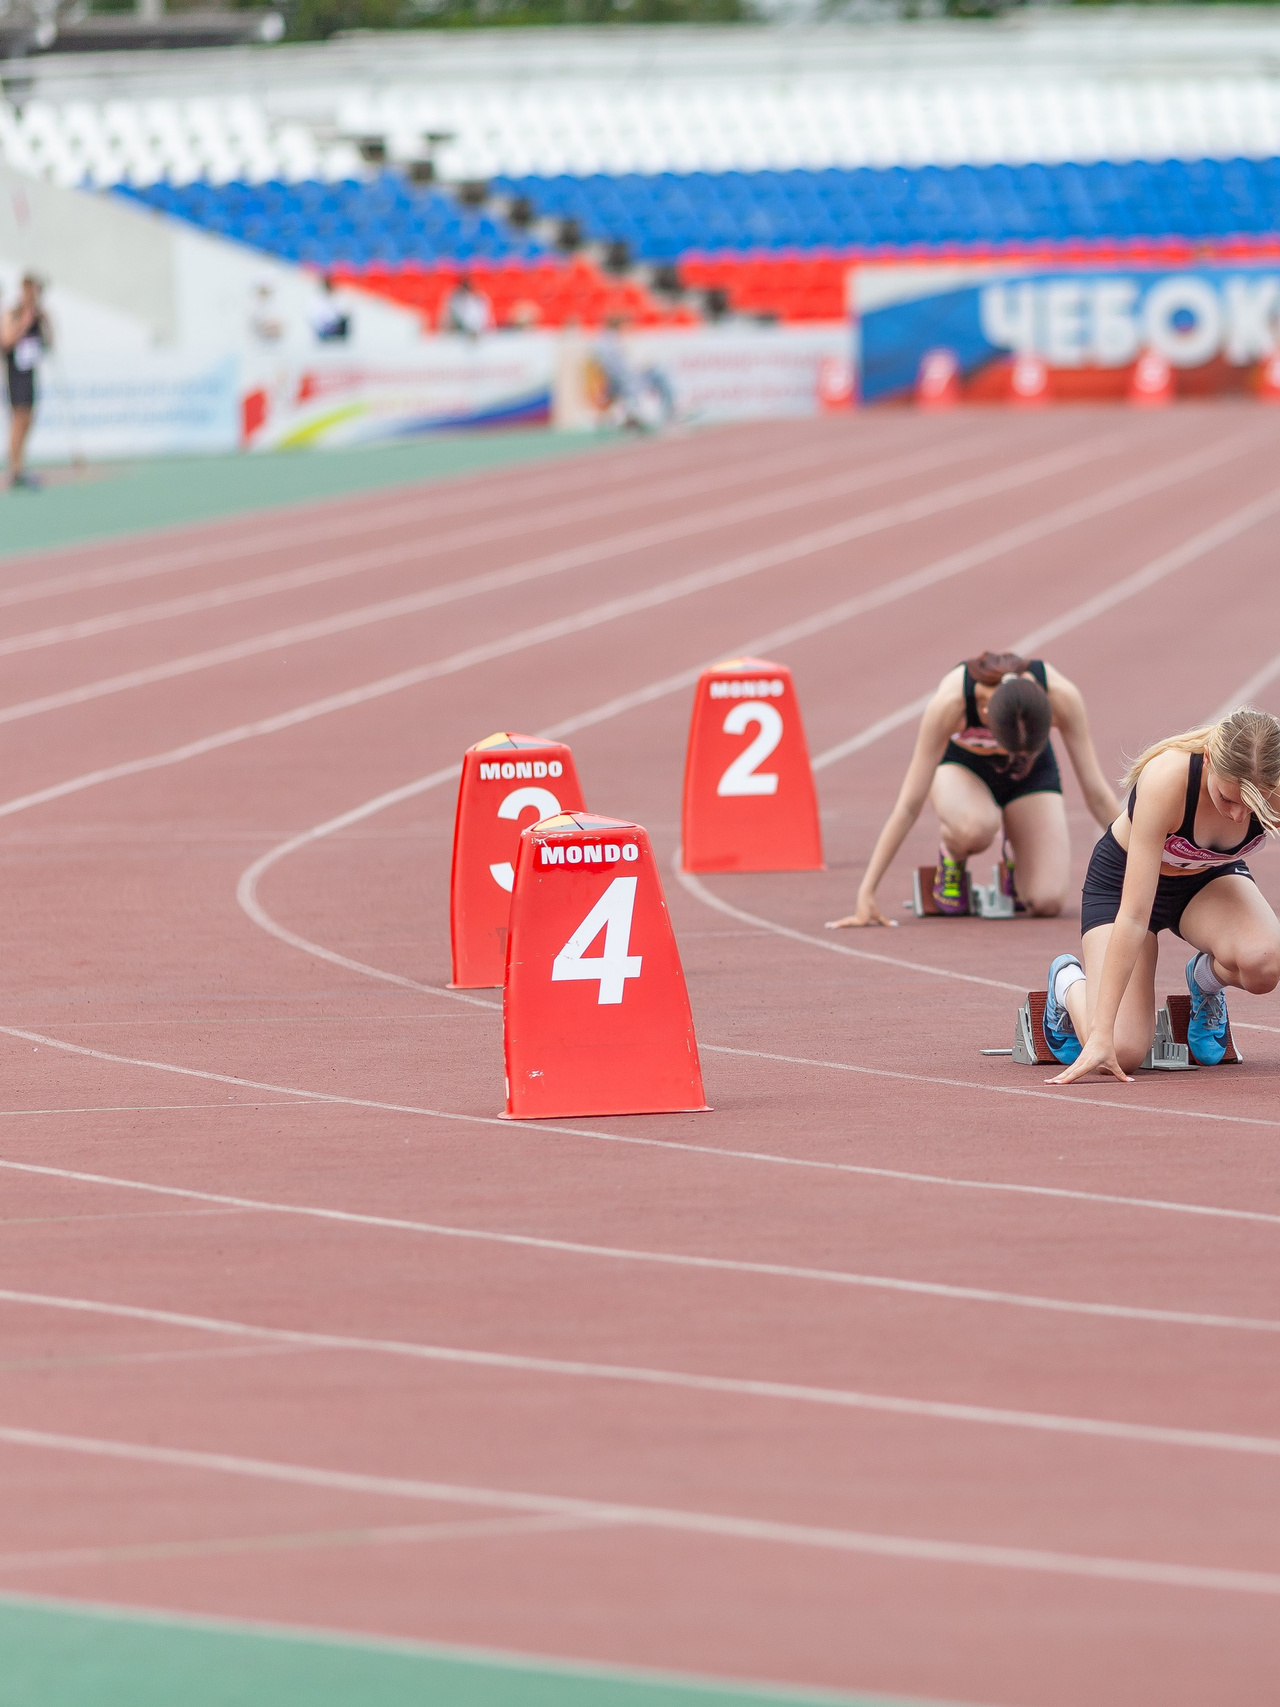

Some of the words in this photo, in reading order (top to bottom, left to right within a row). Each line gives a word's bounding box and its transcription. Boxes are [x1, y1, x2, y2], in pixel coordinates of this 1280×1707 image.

[709, 680, 784, 699] MONDO
[480, 760, 563, 780] MONDO
[717, 700, 784, 797] 2
[489, 786, 563, 893] 3
[541, 843, 639, 865] MONDO
[551, 876, 643, 1005] 4
